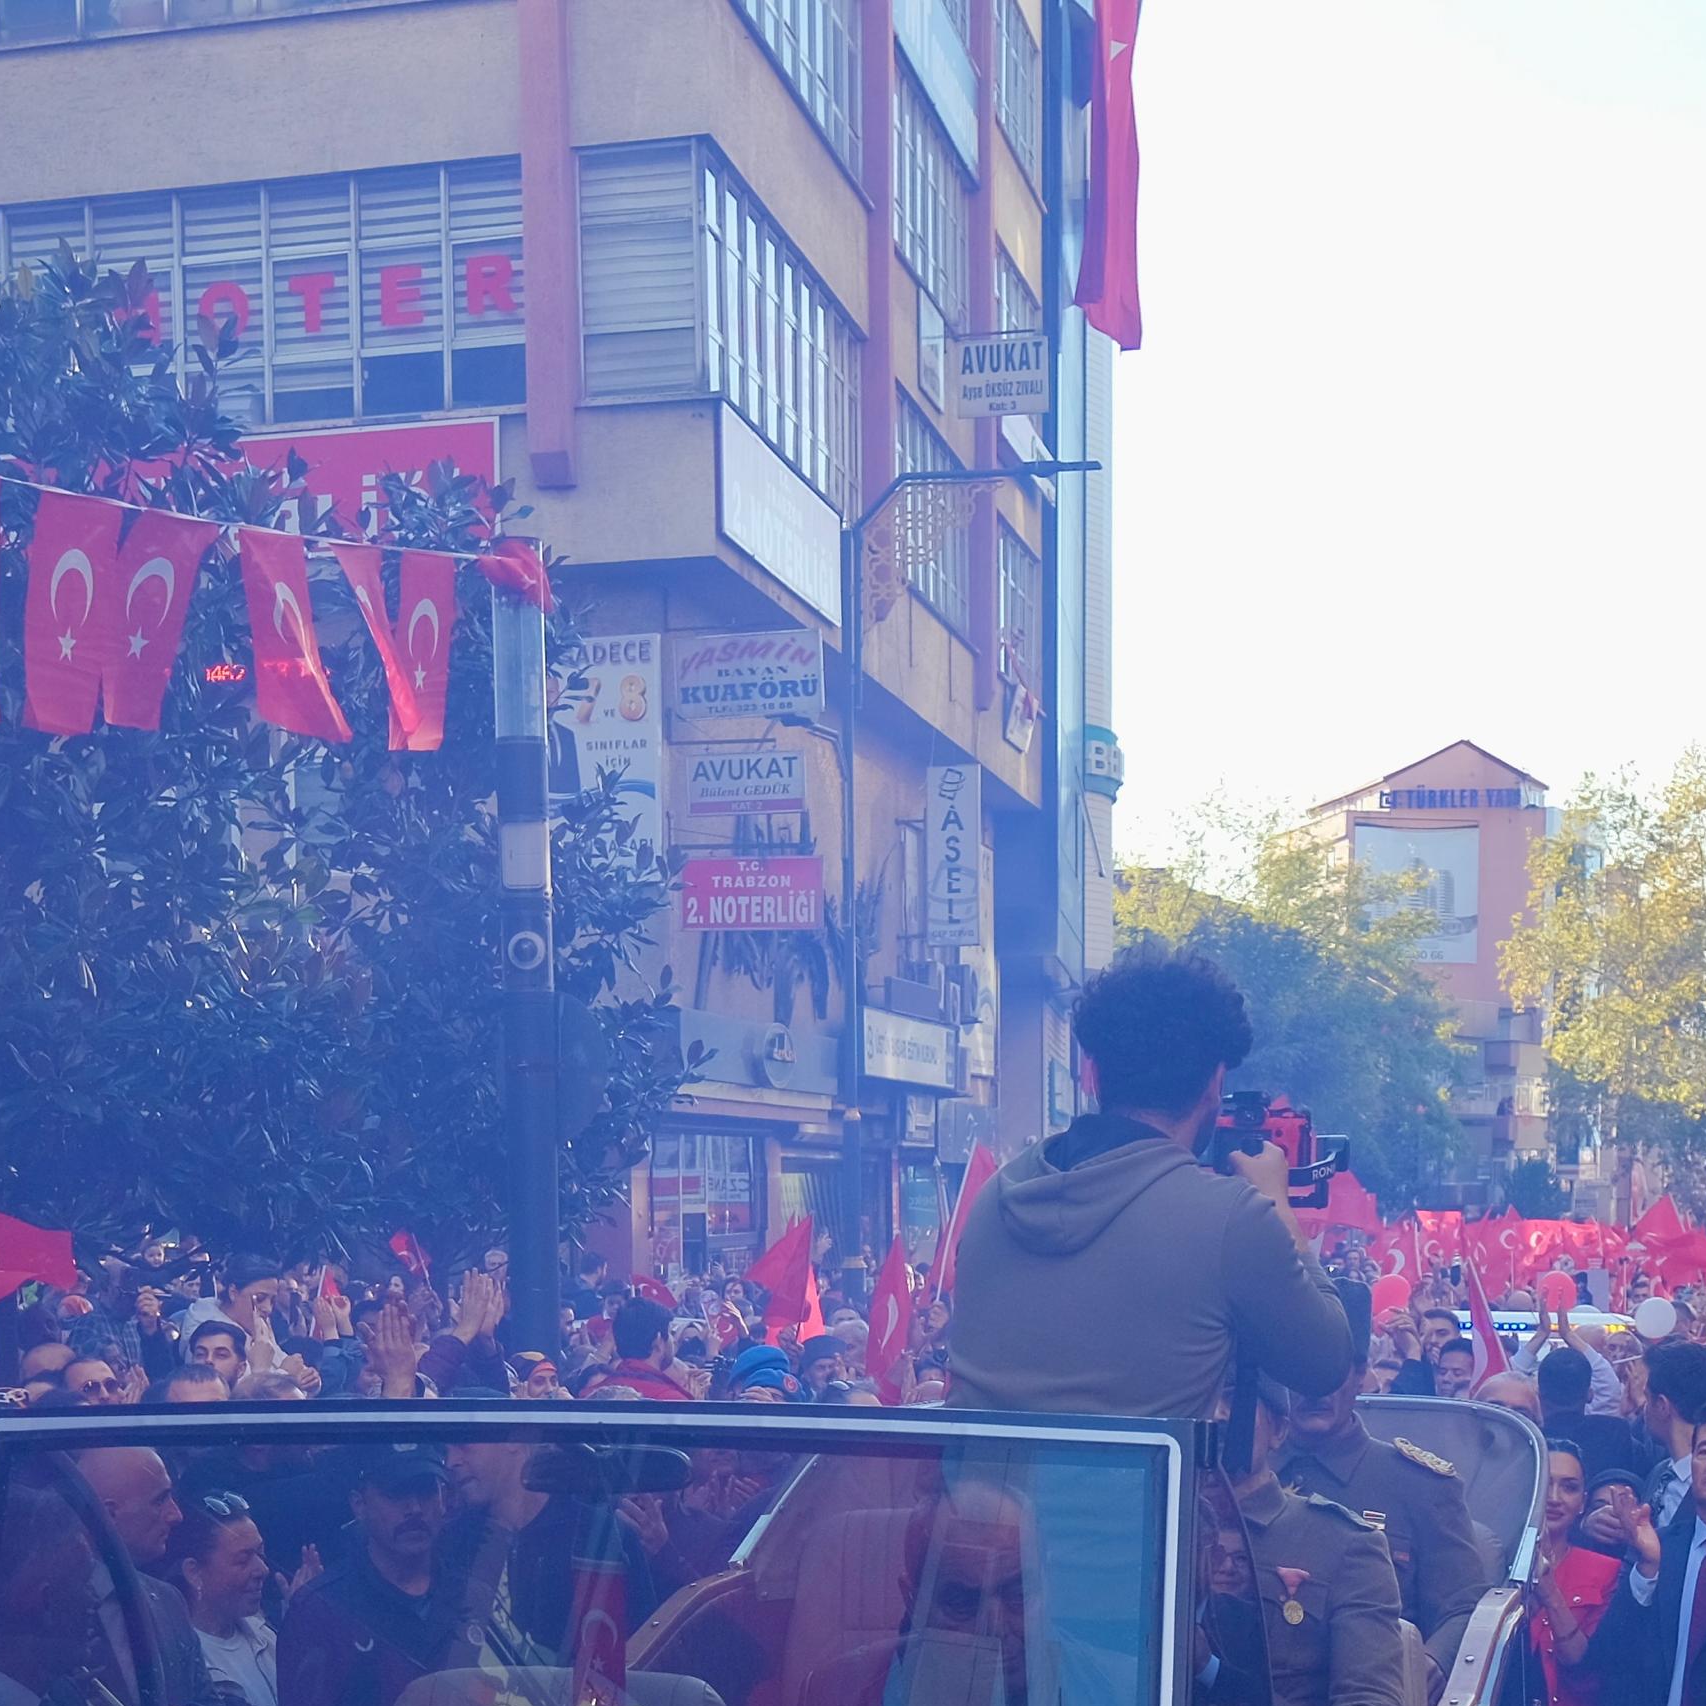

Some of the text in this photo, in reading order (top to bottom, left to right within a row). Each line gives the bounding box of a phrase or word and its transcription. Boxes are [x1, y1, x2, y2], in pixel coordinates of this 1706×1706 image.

[962, 341, 1043, 375] AVUKAT
[569, 640, 651, 666] ADECE
[717, 665, 789, 678] BAYAN
[619, 674, 647, 722] 8
[680, 673, 819, 705] KUAFÖRÜ
[692, 756, 798, 782] AVUKAT
[738, 861, 764, 871] T.C.
[711, 875, 791, 888] TRABZON
[686, 890, 815, 924] 2. NOTERLİĞİ
